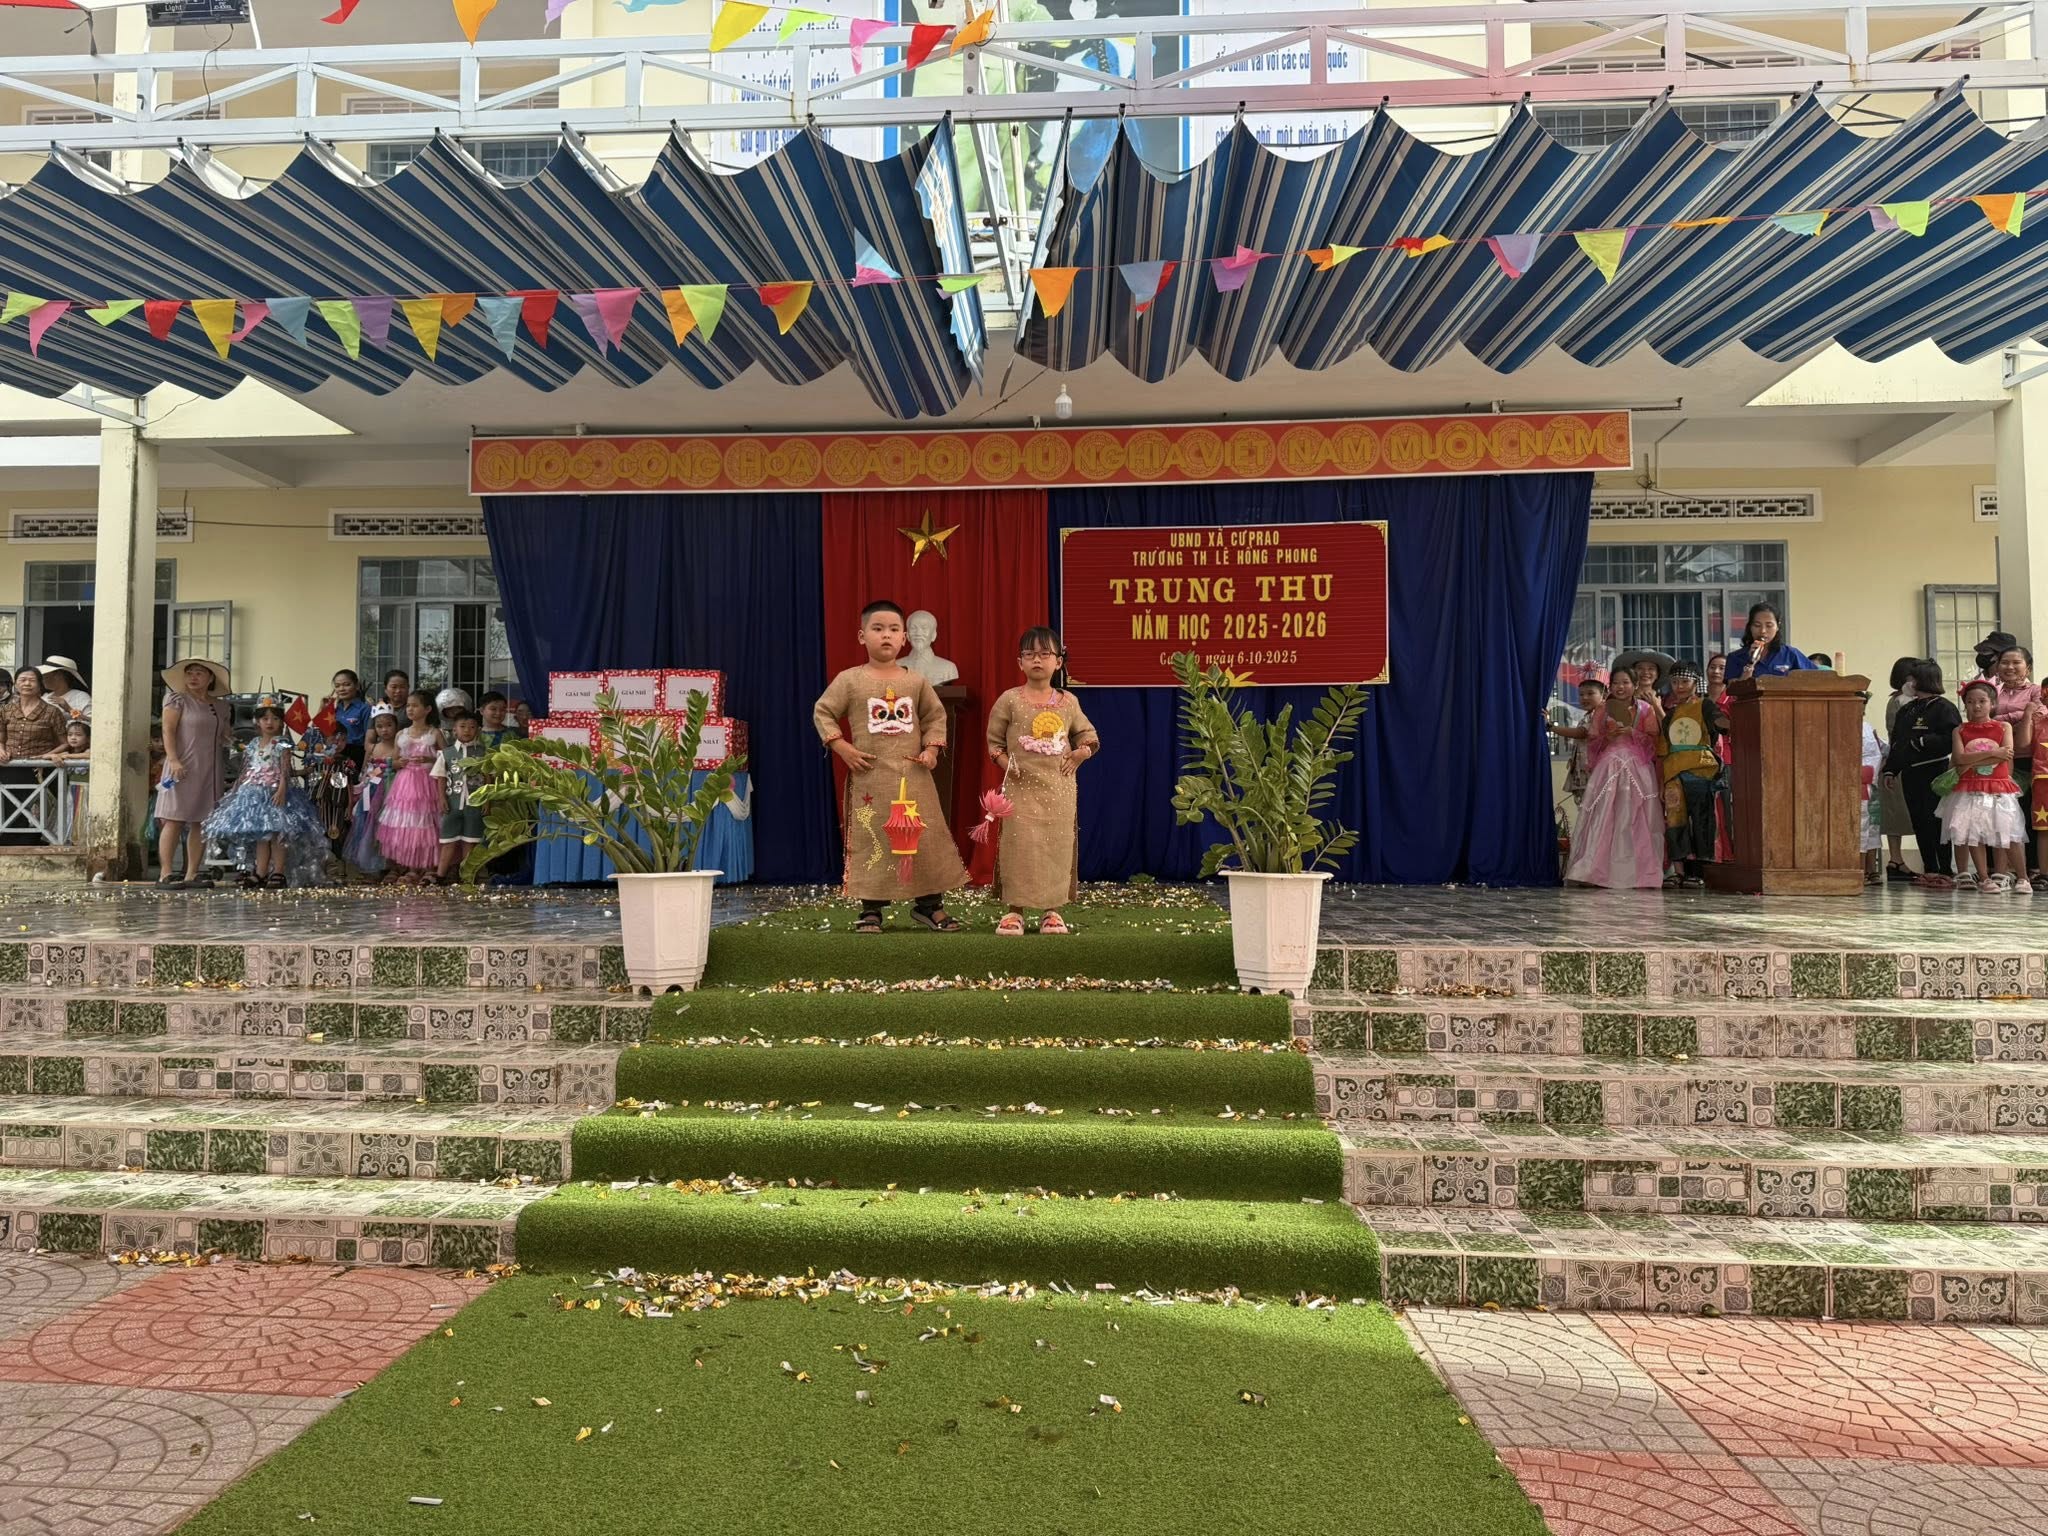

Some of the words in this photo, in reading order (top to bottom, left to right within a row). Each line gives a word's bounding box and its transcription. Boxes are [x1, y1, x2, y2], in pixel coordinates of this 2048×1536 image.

[1281, 49, 1297, 71] các
[1327, 45, 1348, 73] quốc
[1287, 436, 1371, 466] NAM
[1389, 424, 1502, 461] MUÔN
[1170, 532, 1201, 548] UBND
[1208, 527, 1224, 547] XÃ
[1132, 546, 1184, 566] TRƯỜNG
[1192, 550, 1207, 566] TH
[1215, 547, 1229, 565] LÊ
[1237, 545, 1268, 565] HỒNG
[1276, 548, 1318, 564] PHONG
[1109, 577, 1236, 605] TRUNG
[1255, 574, 1334, 602] THU
[1131, 608, 1169, 640] NĂM
[1178, 613, 1210, 646] HỌC
[1205, 650, 1235, 668] ngày
